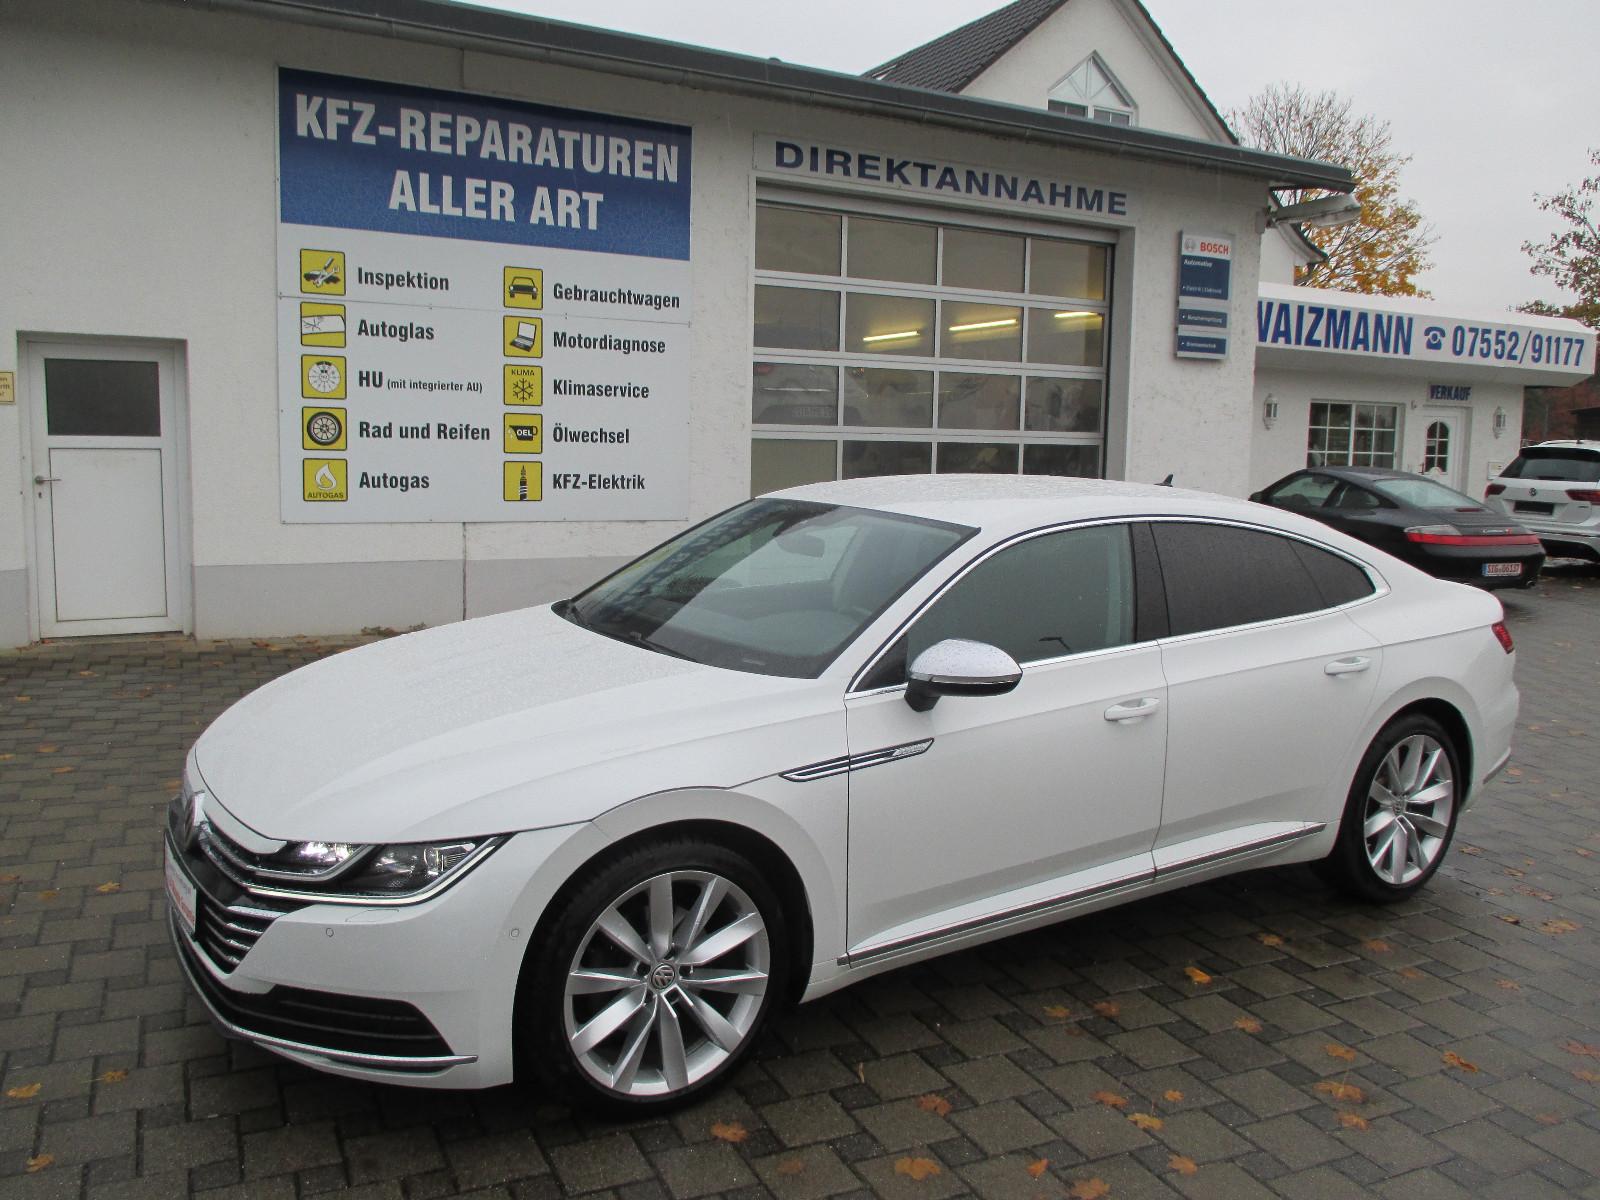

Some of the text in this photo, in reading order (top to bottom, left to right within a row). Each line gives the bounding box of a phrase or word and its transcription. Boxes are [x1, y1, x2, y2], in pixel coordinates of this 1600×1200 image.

[295, 93, 680, 184] KFZ-REPARATUREN
[775, 140, 1128, 216] DIREKTANNAHME
[388, 169, 604, 231] ALLER ART
[1200, 242, 1229, 255] BOSCH
[357, 267, 450, 291] Inspektion
[553, 282, 680, 310] Gebrauchtwagen
[357, 319, 435, 342] Autoglas
[553, 331, 666, 355] Motordiagnose
[1451, 324, 1584, 367] 07552/91177
[358, 370, 483, 394] HU (mit integrierter AU)
[511, 368, 535, 376] KLIMA
[553, 379, 650, 398] Klimaservice
[1430, 384, 1472, 401] VERKAUF
[359, 421, 490, 440] Rad und Reifen
[516, 428, 533, 438] OEL
[553, 422, 630, 444] Ölwechsel
[359, 472, 430, 492] Autogas
[553, 473, 646, 490] KFZ-Elektrik
[307, 491, 344, 499] AUTOGAS
